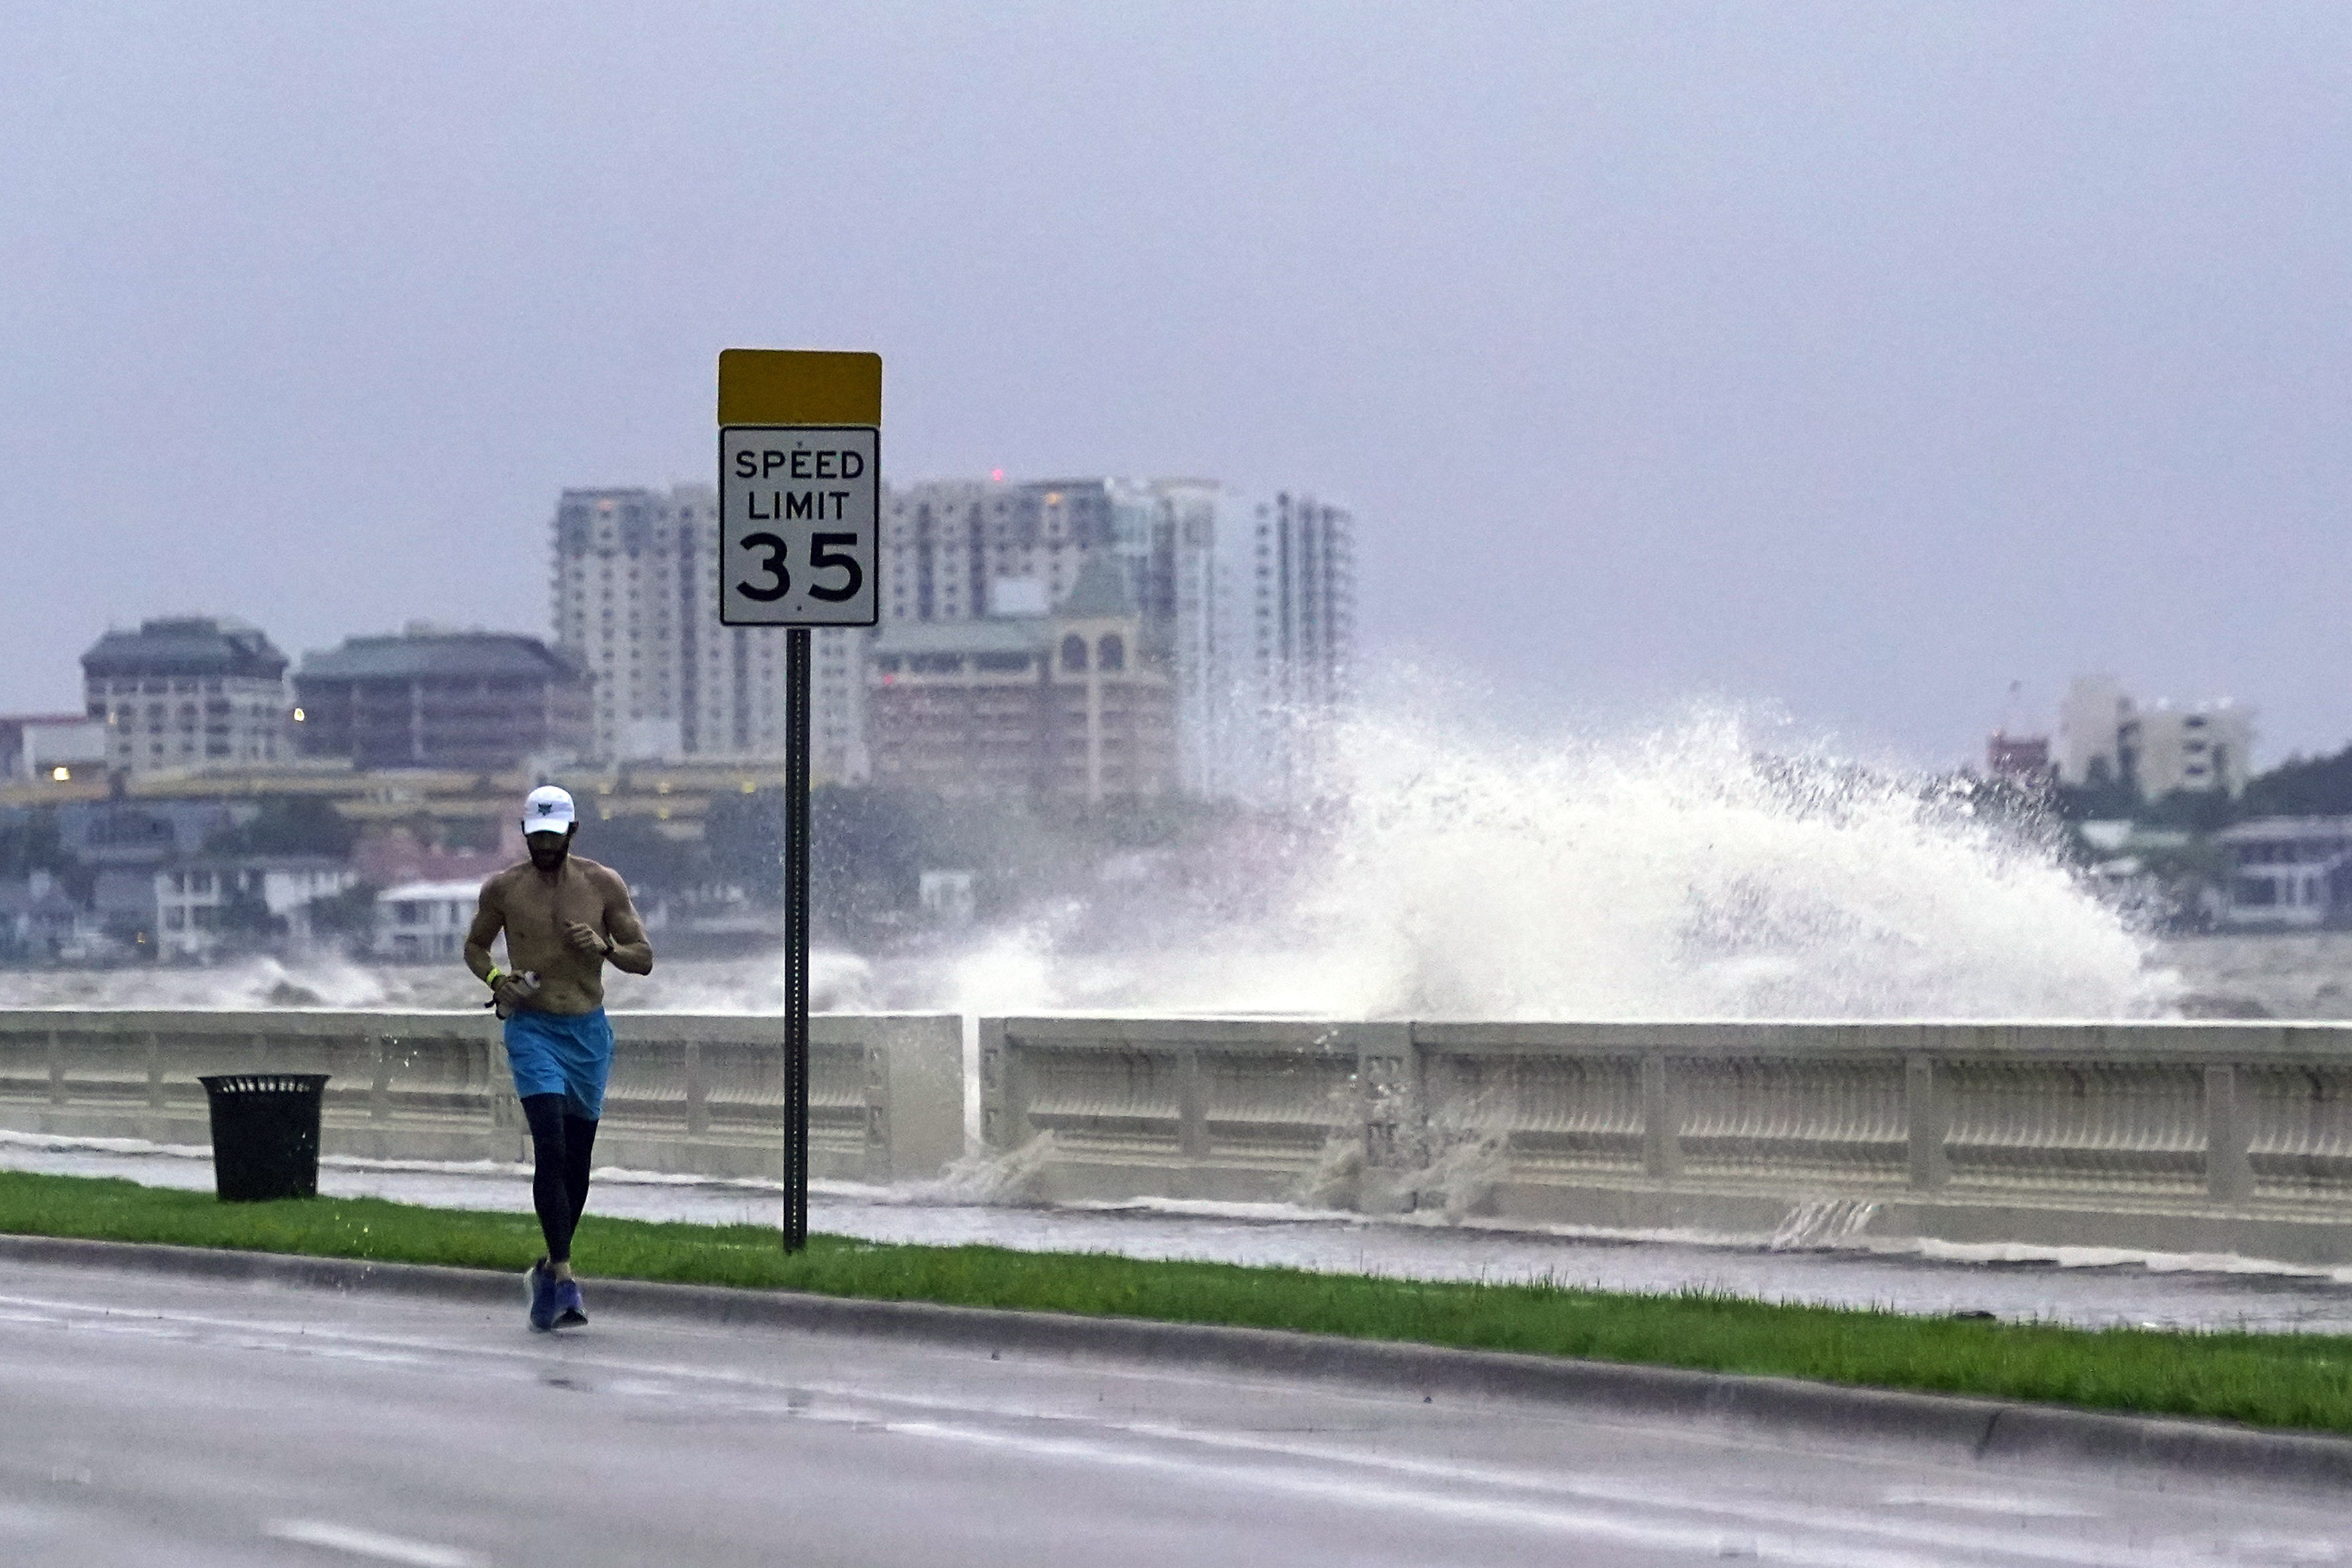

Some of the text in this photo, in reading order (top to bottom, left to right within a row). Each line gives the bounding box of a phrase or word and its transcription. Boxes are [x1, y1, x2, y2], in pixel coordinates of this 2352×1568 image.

[735, 450, 864, 479] SPEED
[748, 490, 850, 520] LIMIT
[735, 532, 863, 603] 35
